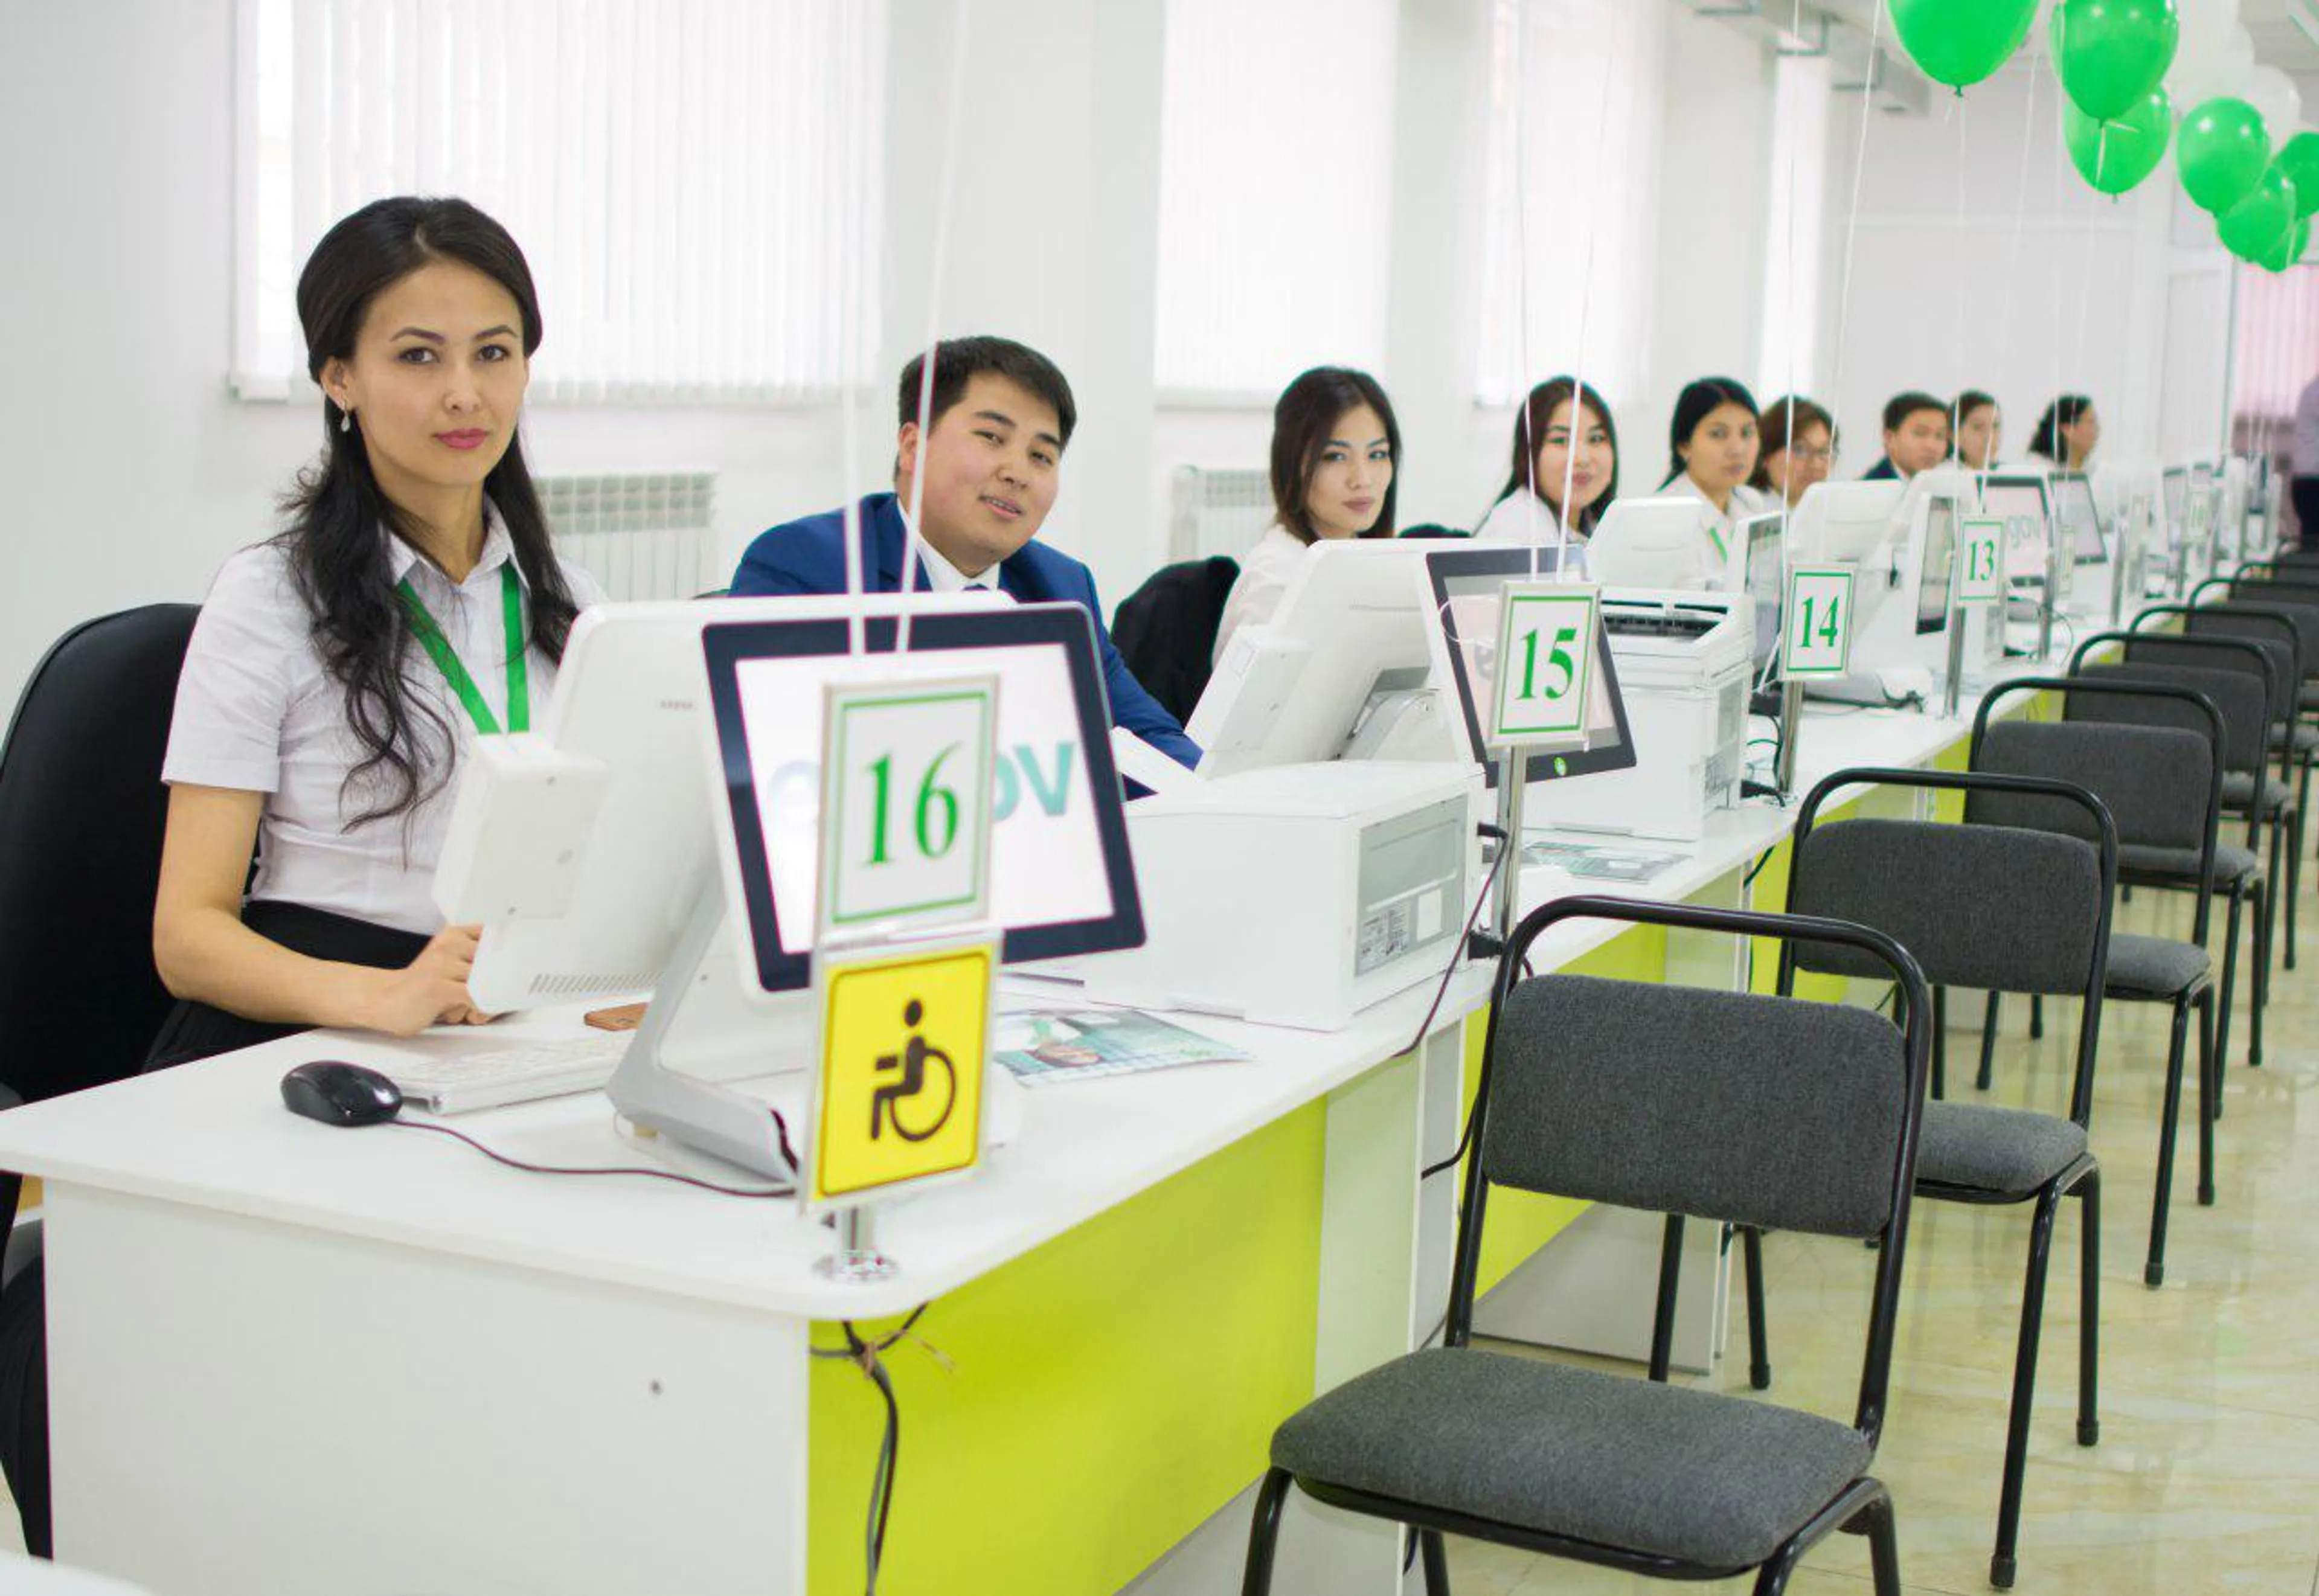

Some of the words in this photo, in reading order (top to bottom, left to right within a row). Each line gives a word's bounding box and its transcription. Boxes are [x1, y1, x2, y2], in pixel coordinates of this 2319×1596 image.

[1968, 539, 1995, 582] 13
[1798, 596, 1839, 648] 14
[1516, 627, 1578, 700] 15
[861, 742, 963, 867] 16
